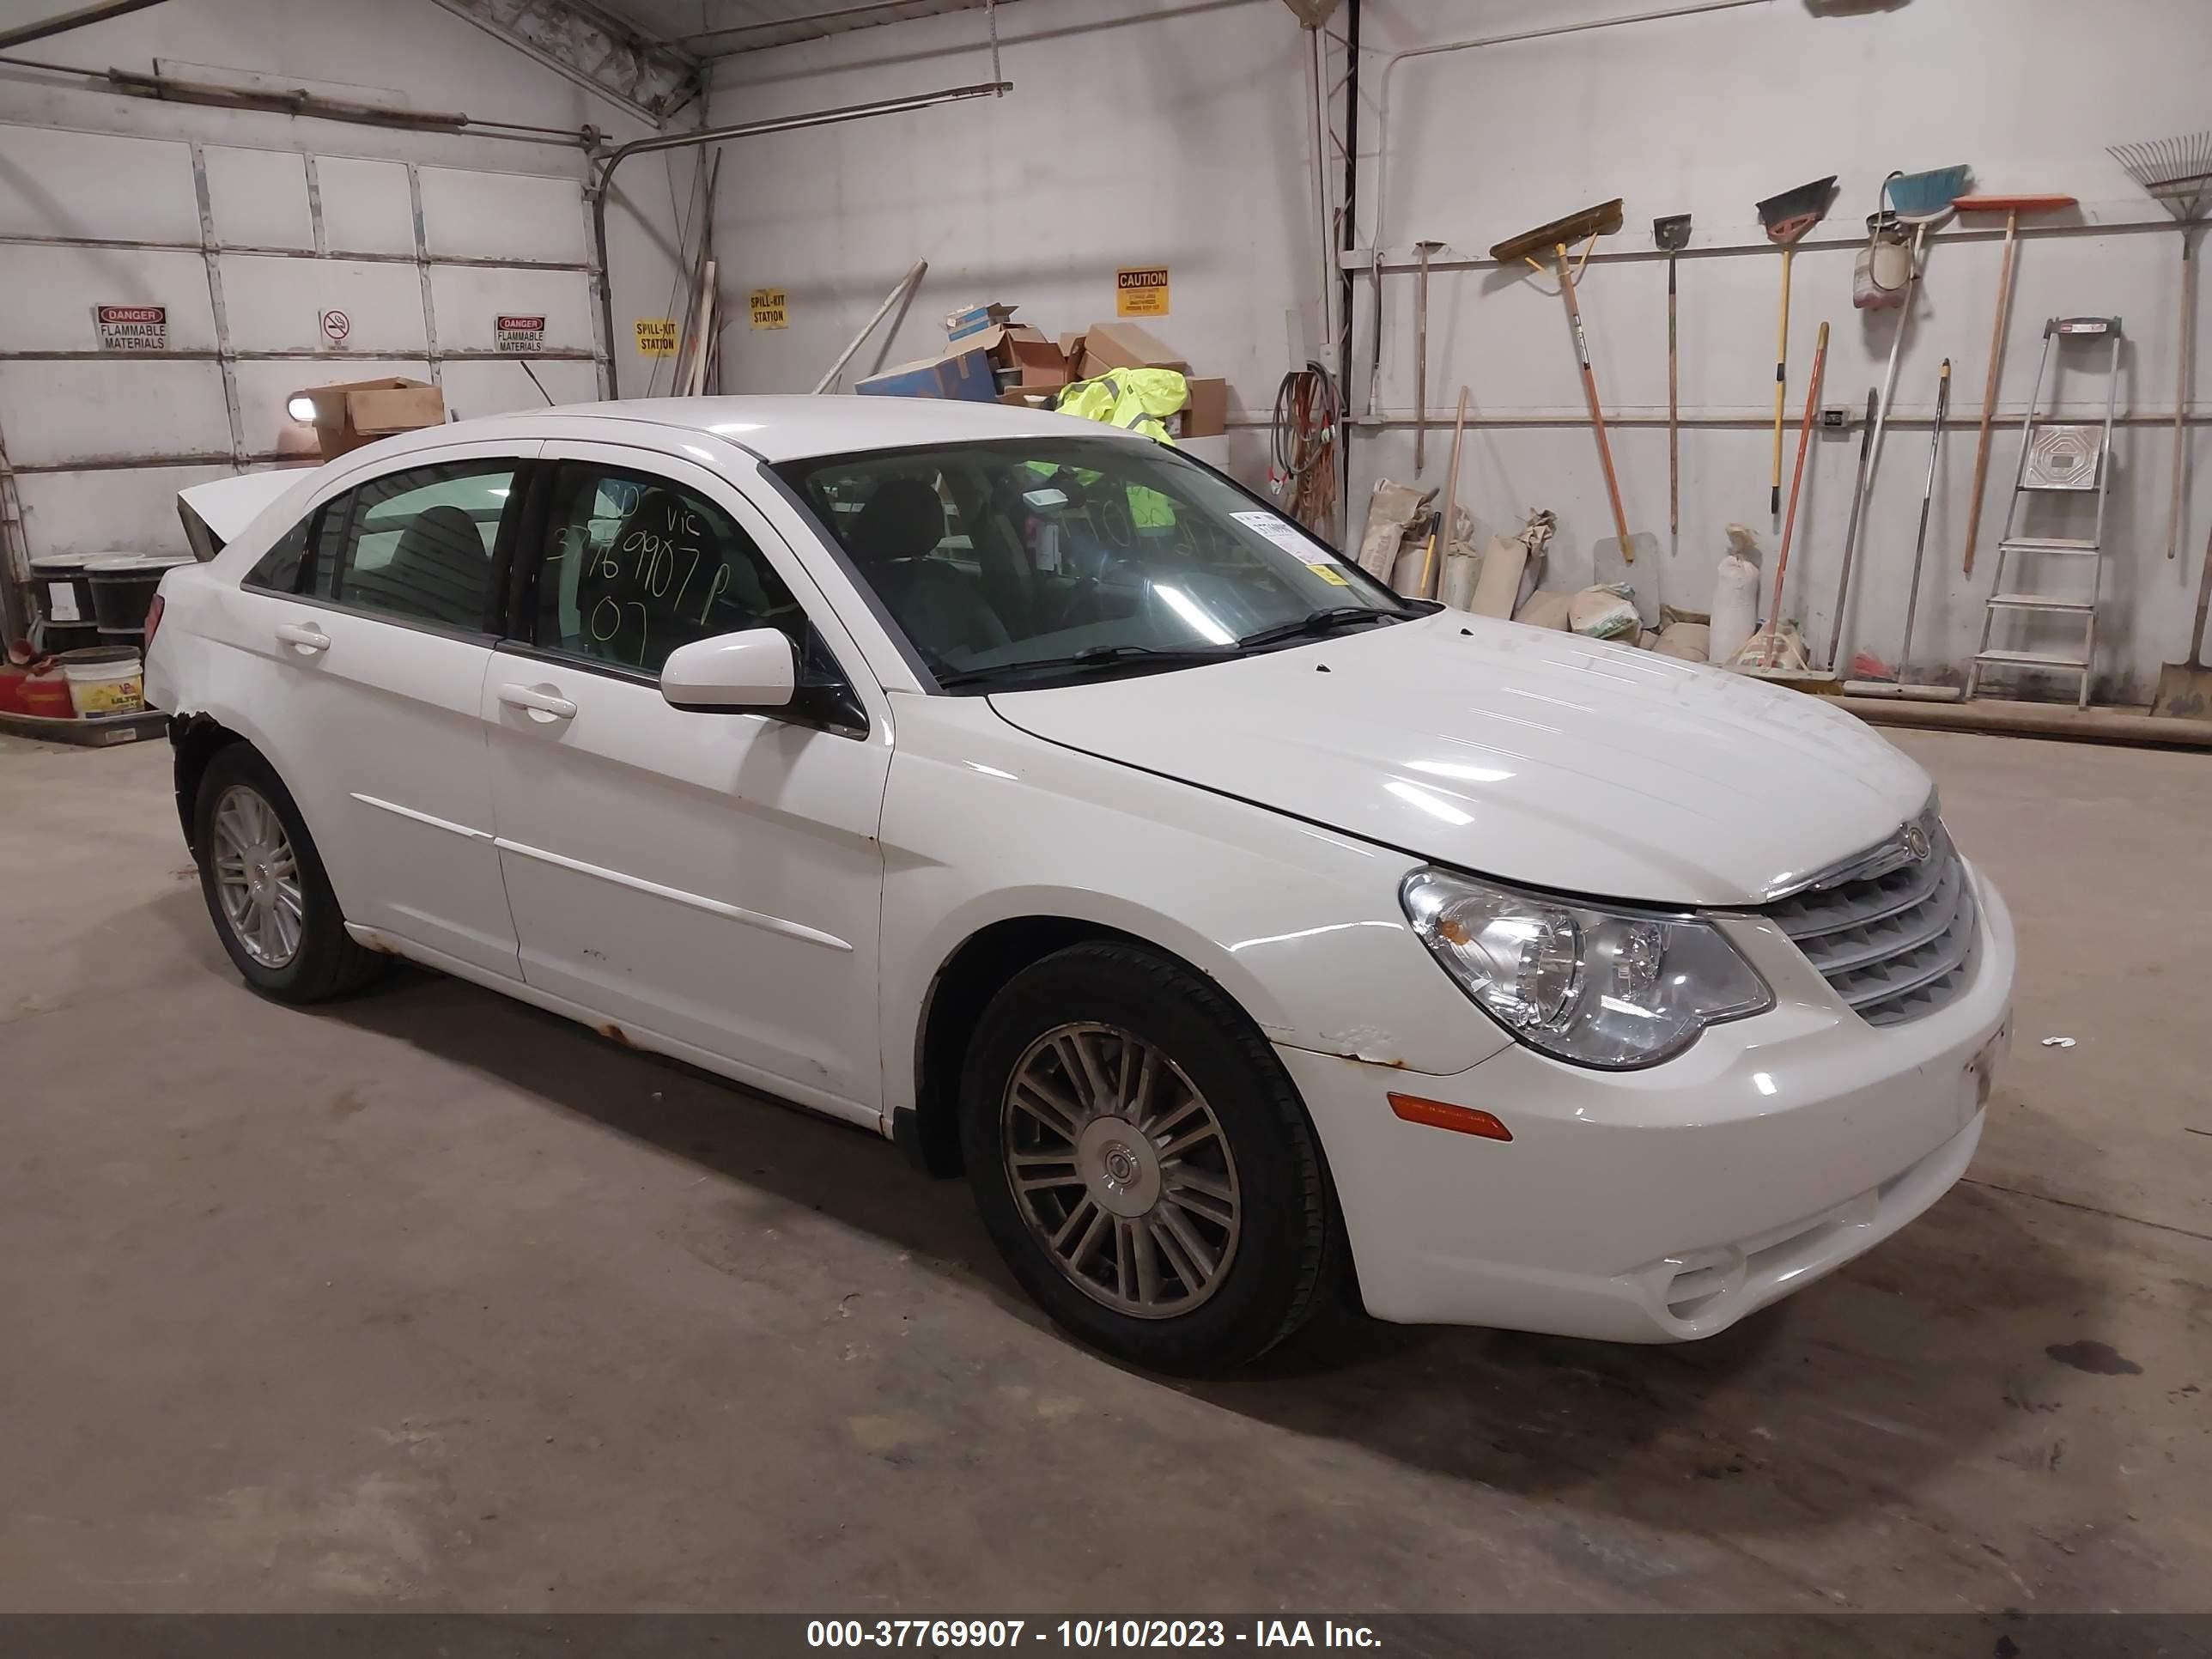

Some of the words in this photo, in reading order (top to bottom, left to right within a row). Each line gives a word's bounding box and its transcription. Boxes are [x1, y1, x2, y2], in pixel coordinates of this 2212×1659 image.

[1120, 272, 1166, 287] CAUTION
[750, 295, 785, 308] SPILL-KIT
[108, 310, 156, 320] DANGER
[754, 310, 784, 323] STATION
[504, 319, 538, 328] DANGER
[636, 323, 676, 335] SPILL-KIT
[100, 325, 167, 337] FLAMMABLE
[497, 331, 544, 341] FLAMMABLE
[105, 337, 165, 349] MATERIALS
[500, 342, 542, 351] MATERIALS
[641, 338, 674, 349] STATION
